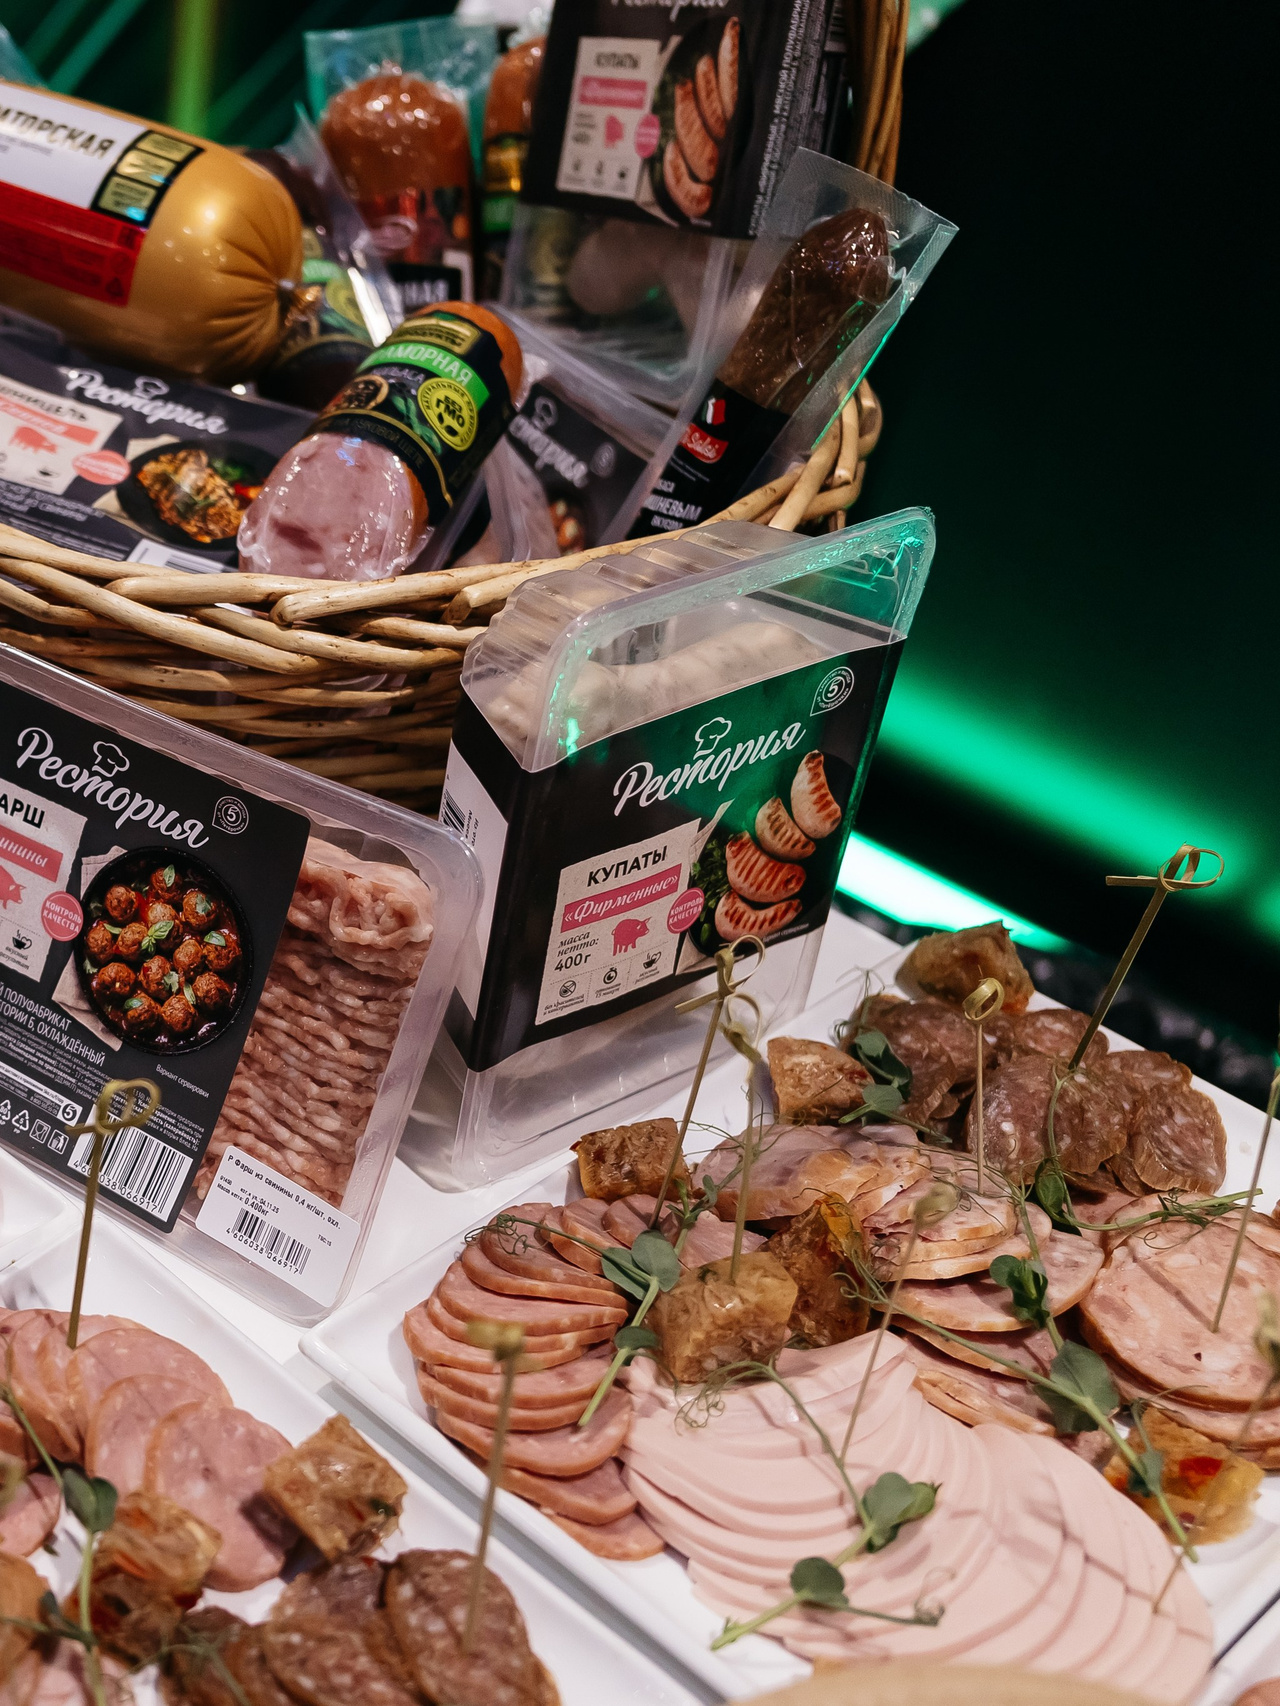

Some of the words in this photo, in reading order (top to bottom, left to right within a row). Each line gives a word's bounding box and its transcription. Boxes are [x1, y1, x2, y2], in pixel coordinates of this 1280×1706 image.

[436, 398, 466, 428] ГМО
[443, 395, 463, 414] БЕЗ
[827, 677, 841, 698] 5
[613, 722, 807, 817] Рестория
[16, 727, 210, 849] Рестория
[587, 845, 668, 887] КУПАТЫ
[45, 901, 82, 924] КОНТРОЛЬ
[564, 875, 678, 923] «Фирменные»
[670, 895, 704, 916] КОНТРОЛЬ
[42, 910, 80, 933] КАЧЕСТВА
[668, 906, 702, 924] КАЧЕСТВА
[556, 938, 600, 958] нетто:
[557, 930, 591, 949] масса
[3, 987, 72, 1032] ПОЛУФАБРИКАТ
[27, 1017, 36, 1032] Б,
[36, 1021, 106, 1067] ОХЛАЖДЁННЫЙ
[155, 1063, 179, 1081] Вариант
[177, 1075, 211, 1099] сервировки
[62, 1104, 77, 1119] 5
[120, 1186, 158, 1213] 066917
[234, 1159, 254, 1175] Фарш
[254, 1171, 264, 1181] из
[264, 1176, 294, 1199] свинины
[294, 1195, 306, 1207] 0,4
[305, 1201, 326, 1221] кг/шт,
[326, 1215, 342, 1230] охл.
[233, 1232, 264, 1255] 606038
[266, 1251, 299, 1275] 066917
